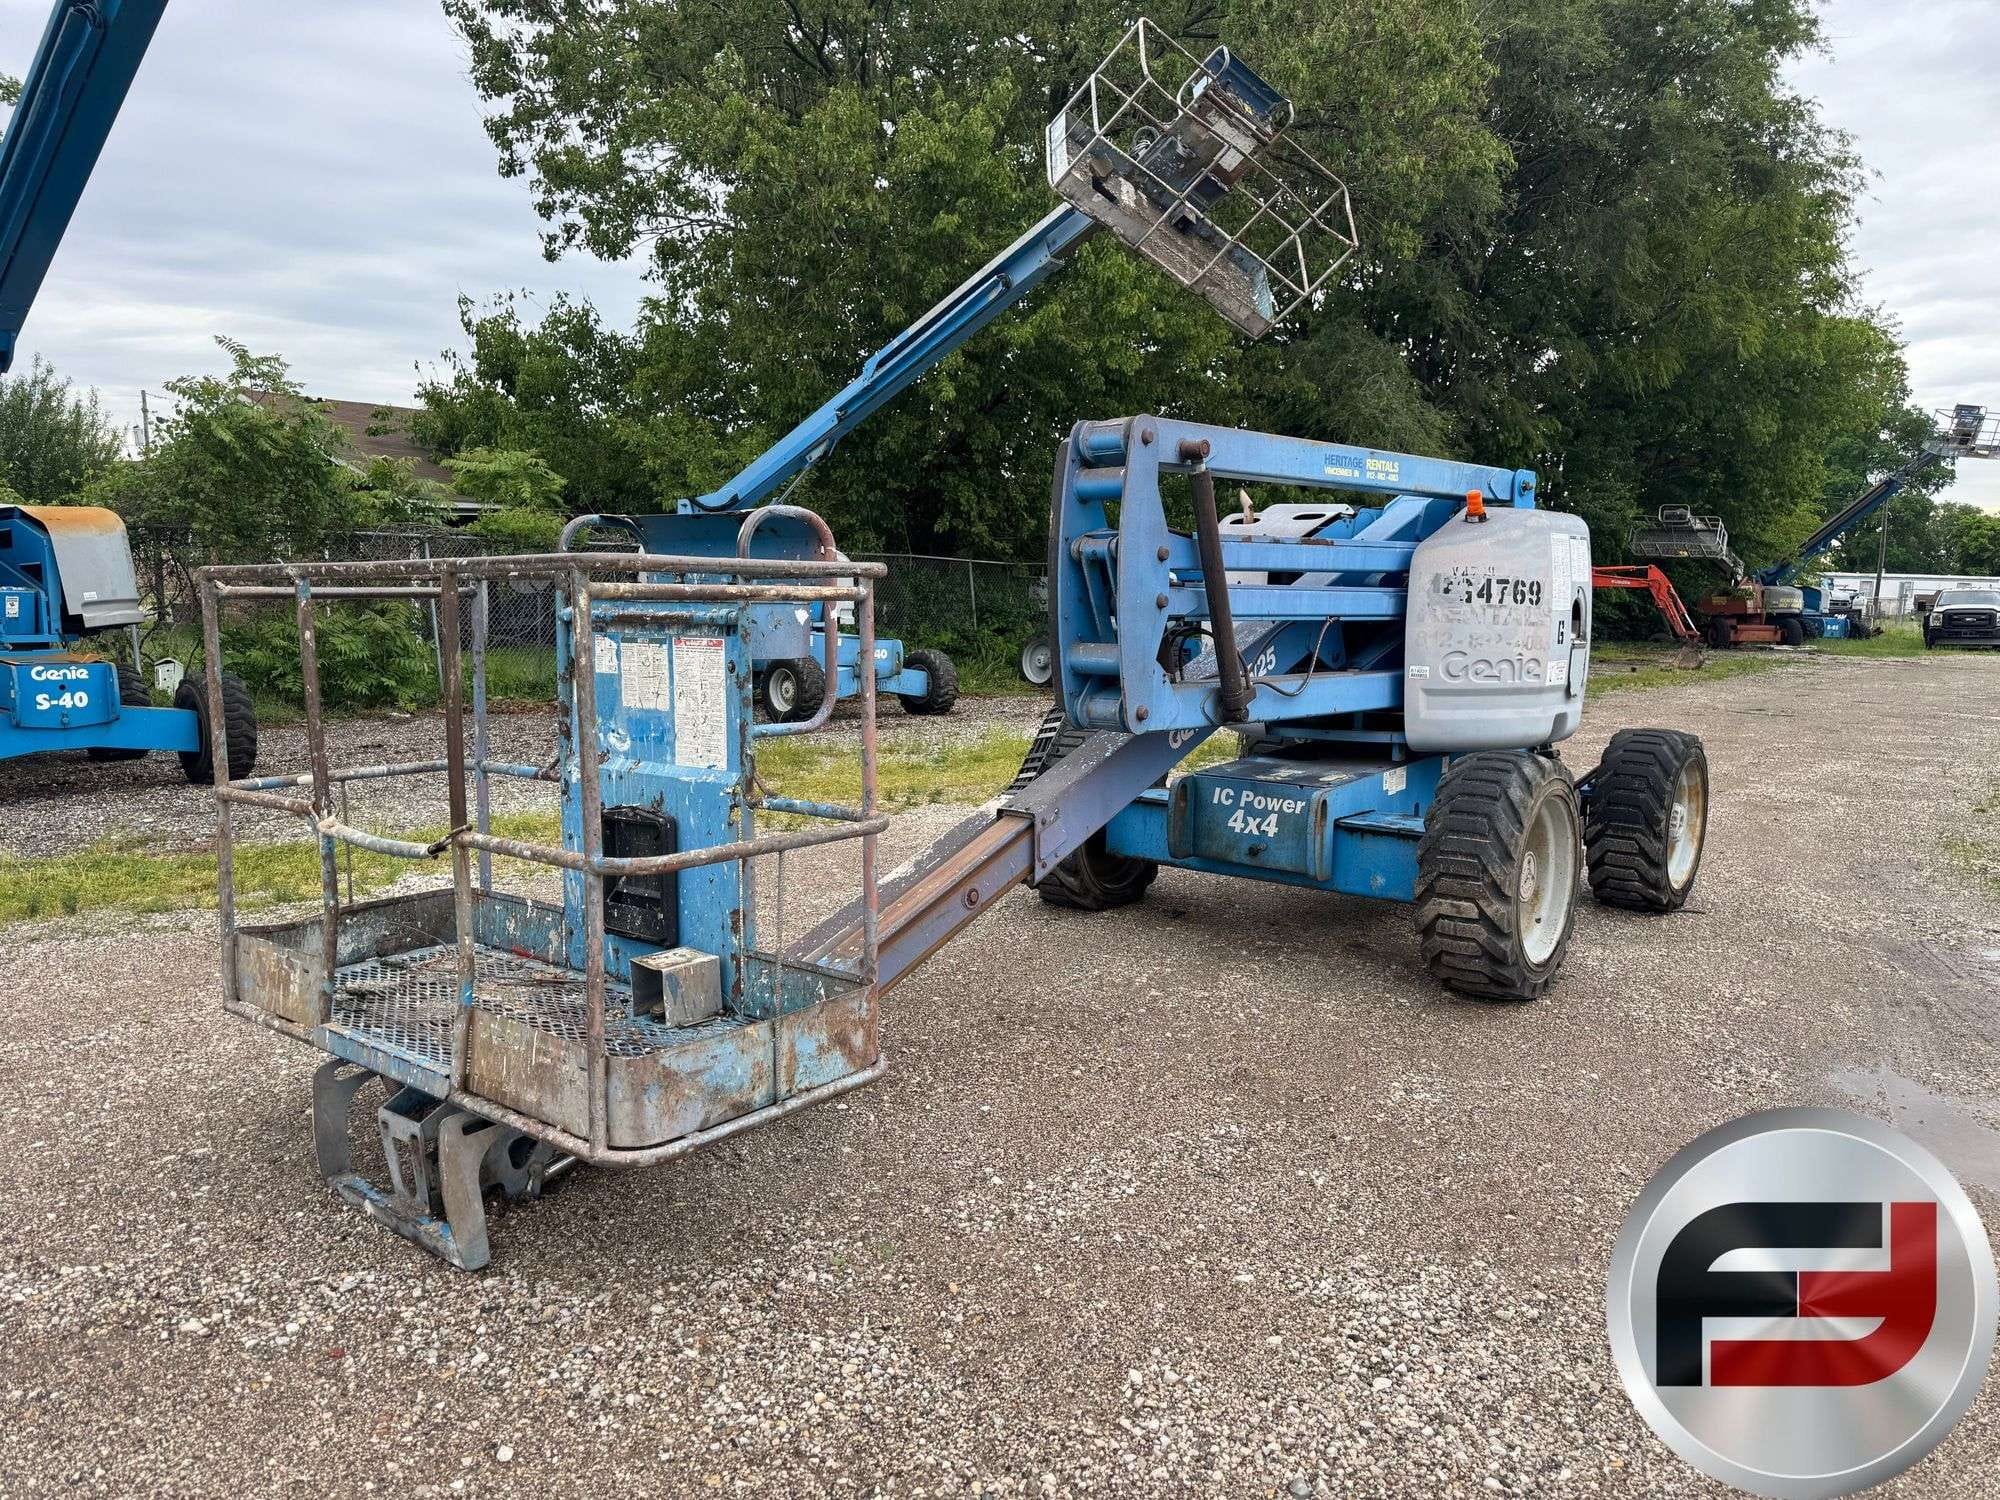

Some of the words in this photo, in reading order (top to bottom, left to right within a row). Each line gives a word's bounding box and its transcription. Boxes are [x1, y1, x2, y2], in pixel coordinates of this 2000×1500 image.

[1324, 453, 1363, 469] HERITAGE
[1366, 458, 1399, 473] RENTALS
[30, 665, 89, 681] Genie
[1440, 650, 1541, 684] Genie
[35, 691, 89, 711] S-40
[1212, 787, 1235, 806] IC
[1240, 790, 1306, 815] Power
[1227, 809, 1279, 838] 4x4
